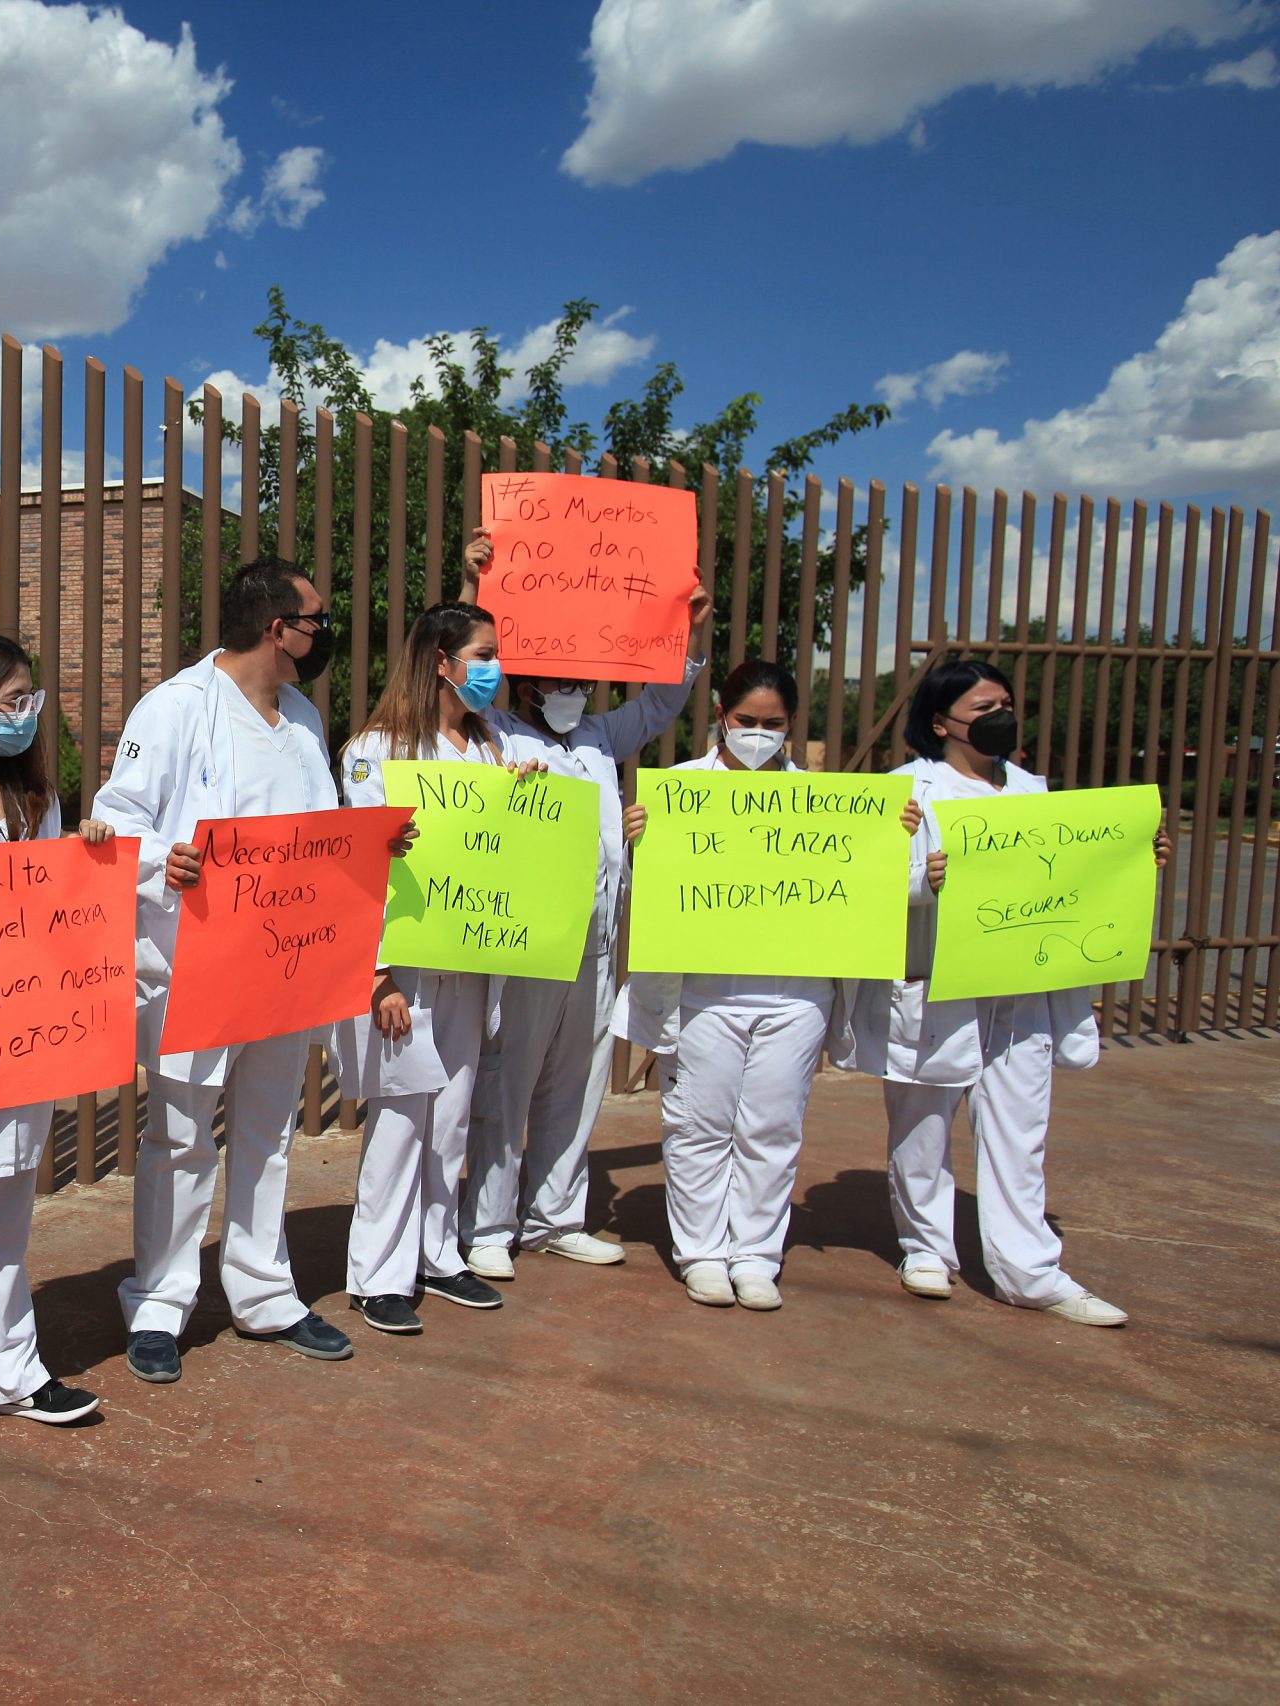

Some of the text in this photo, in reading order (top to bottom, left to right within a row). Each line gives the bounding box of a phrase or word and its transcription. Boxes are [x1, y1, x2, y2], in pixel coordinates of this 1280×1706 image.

[564, 497, 658, 524] Muertos
[510, 531, 644, 566] no dan
[500, 616, 577, 655] Plazas
[508, 779, 563, 823] falta
[731, 789, 782, 816] UNA
[201, 827, 353, 867] Necesitamos
[465, 831, 501, 854] una
[686, 825, 852, 863] DE PLAZAS
[950, 815, 1125, 856] PLAZAS DIGNAS
[1038, 853, 1056, 880] Y
[234, 874, 316, 913] Plazas
[427, 875, 514, 919] MASSYEL
[680, 878, 848, 912] INFORMADA
[976, 889, 1079, 927] SEGURAS
[263, 919, 336, 980] Seguras
